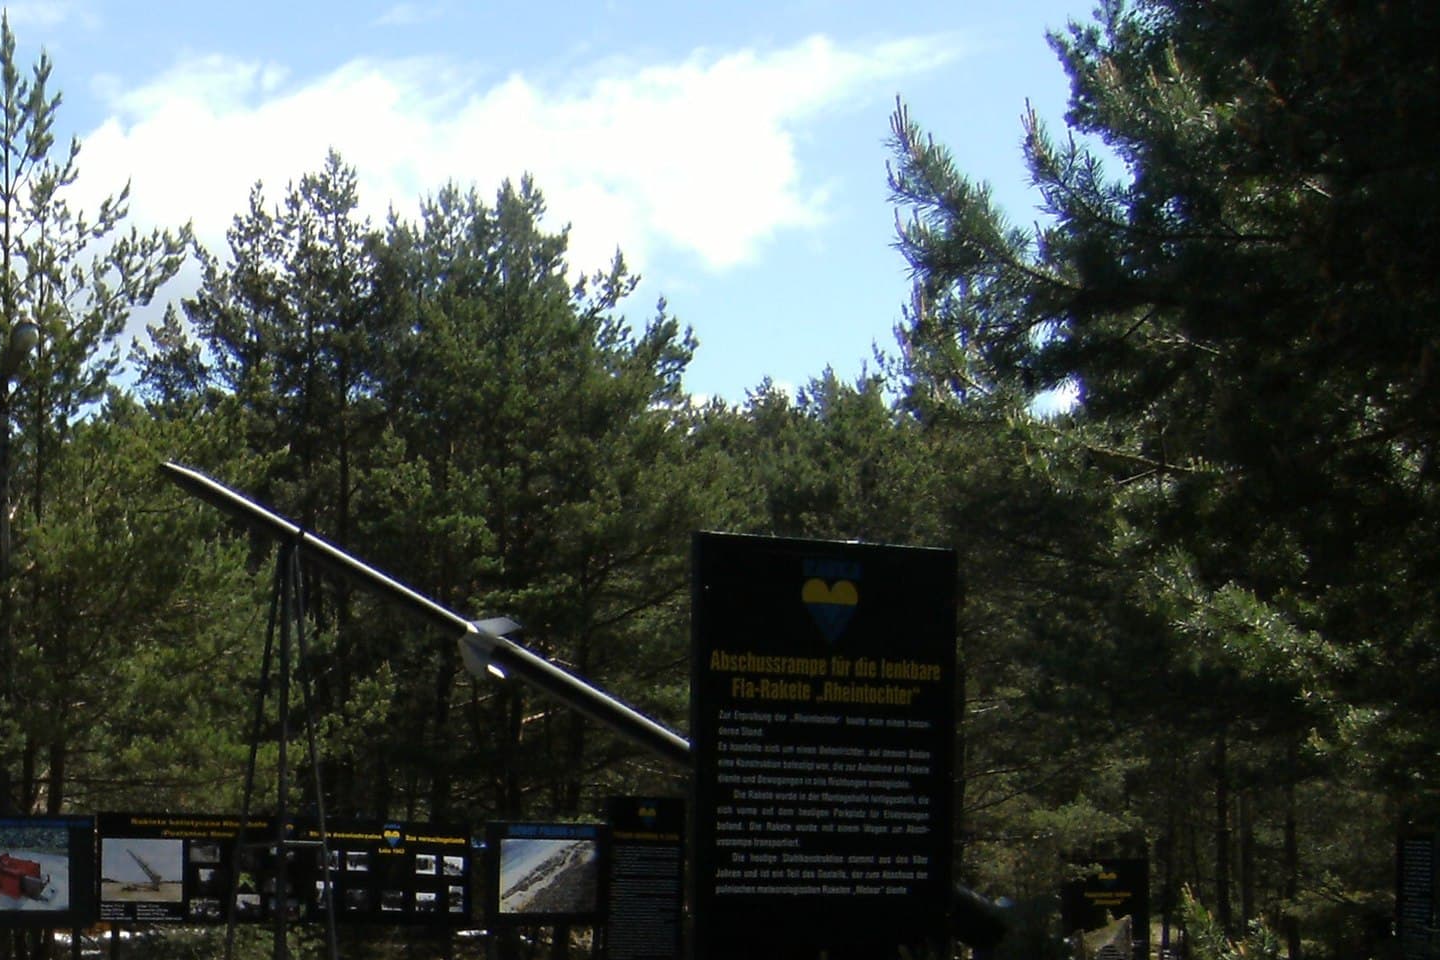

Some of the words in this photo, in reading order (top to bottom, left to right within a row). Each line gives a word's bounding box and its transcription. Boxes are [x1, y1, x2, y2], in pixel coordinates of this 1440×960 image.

[710, 649, 827, 677] Abschussrampe
[831, 656, 851, 677] für
[855, 657, 877, 677] die
[881, 657, 942, 681] lenkbare
[732, 677, 811, 700] Fla-Rakete
